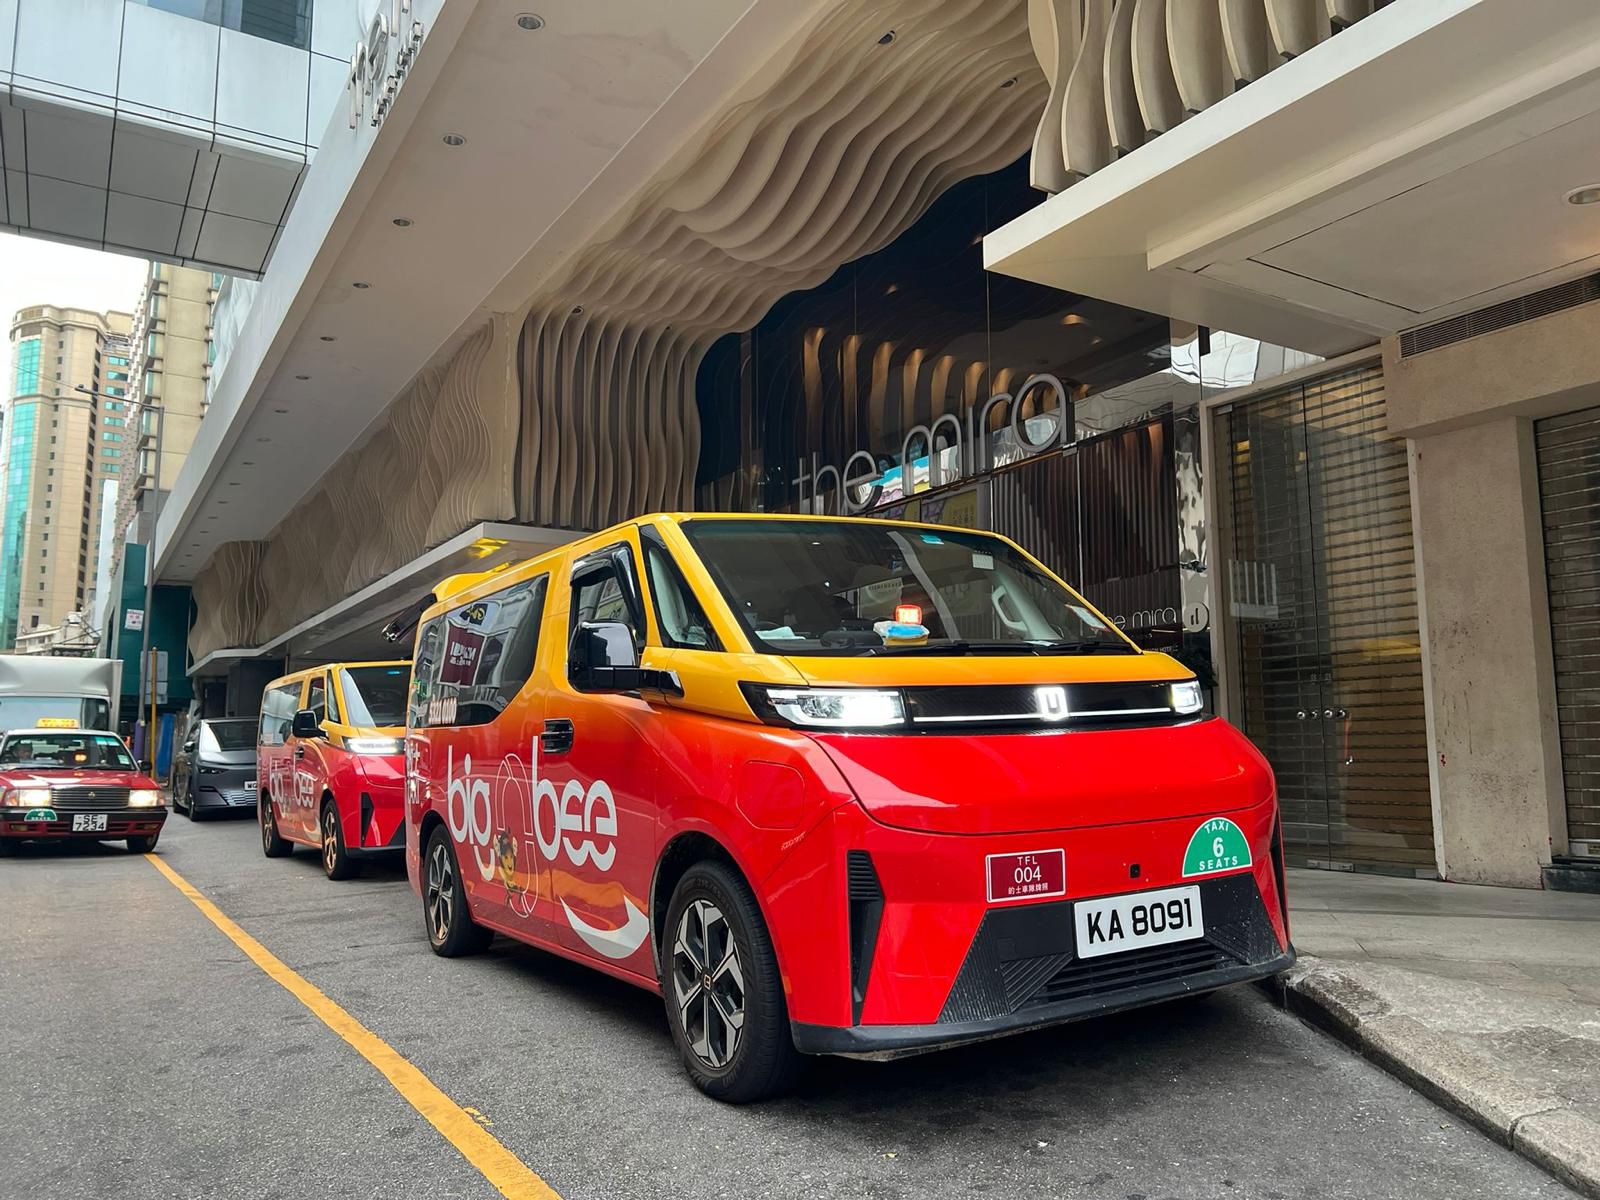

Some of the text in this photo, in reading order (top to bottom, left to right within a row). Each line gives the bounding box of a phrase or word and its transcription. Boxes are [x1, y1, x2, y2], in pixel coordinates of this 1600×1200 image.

[791, 373, 1075, 514] the mira
[1132, 607, 1177, 629] mira
[448, 745, 495, 882] big
[532, 735, 618, 872] bee
[75, 823, 105, 831] 7234
[83, 815, 98, 823] SE
[1204, 820, 1229, 835] TAXI
[1212, 836, 1224, 858] 6
[1017, 855, 1038, 866] TFL
[1198, 856, 1239, 871] SEATS
[1014, 866, 1042, 884] 004
[1087, 898, 1194, 944] KA 8091
